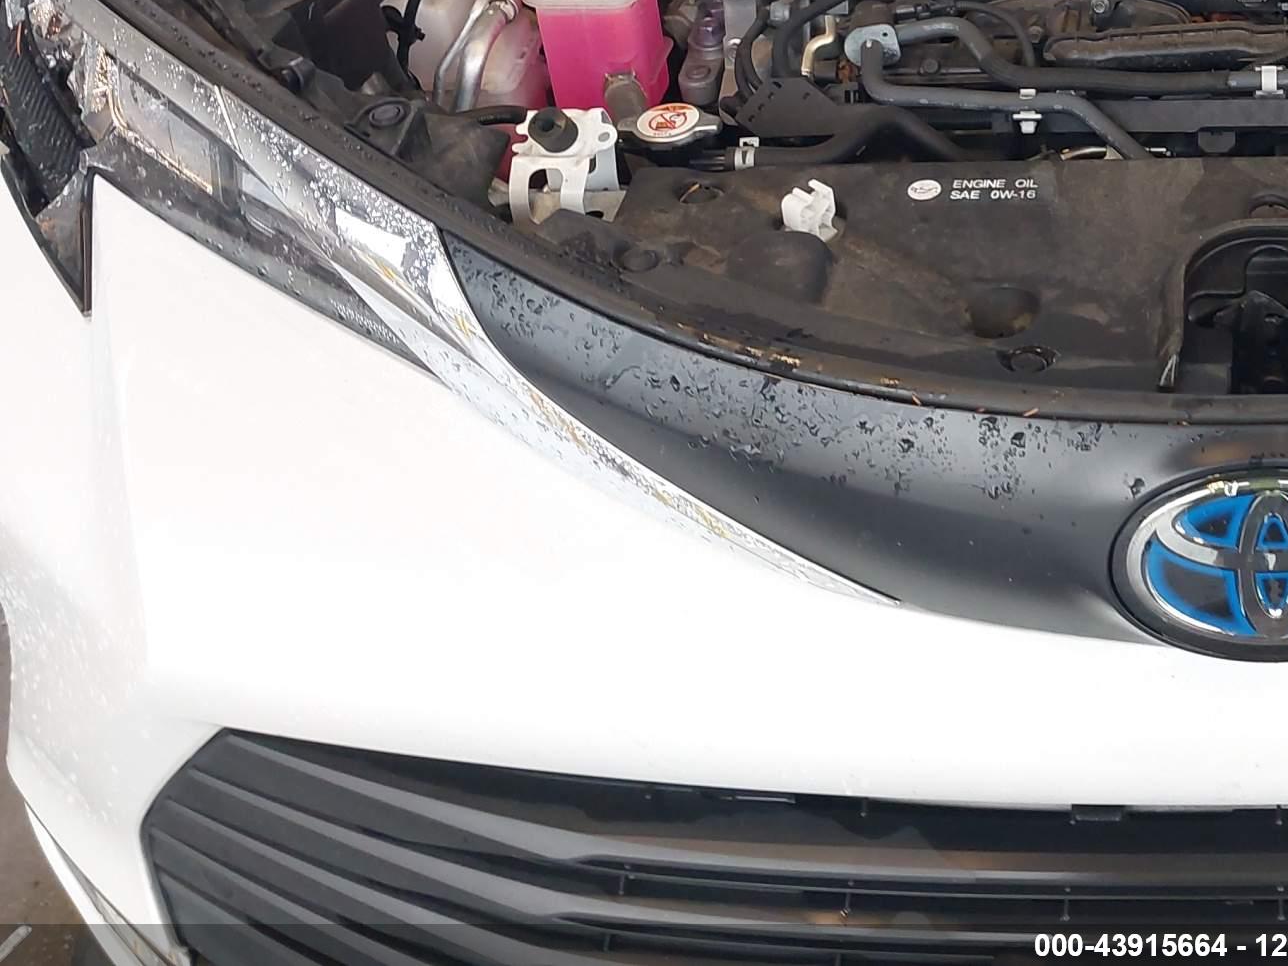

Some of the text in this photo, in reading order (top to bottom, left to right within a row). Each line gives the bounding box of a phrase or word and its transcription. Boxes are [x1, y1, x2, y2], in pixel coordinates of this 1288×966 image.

[952, 178, 1039, 189] ENGINE OIL
[950, 189, 1036, 200] SAE 0W-16
